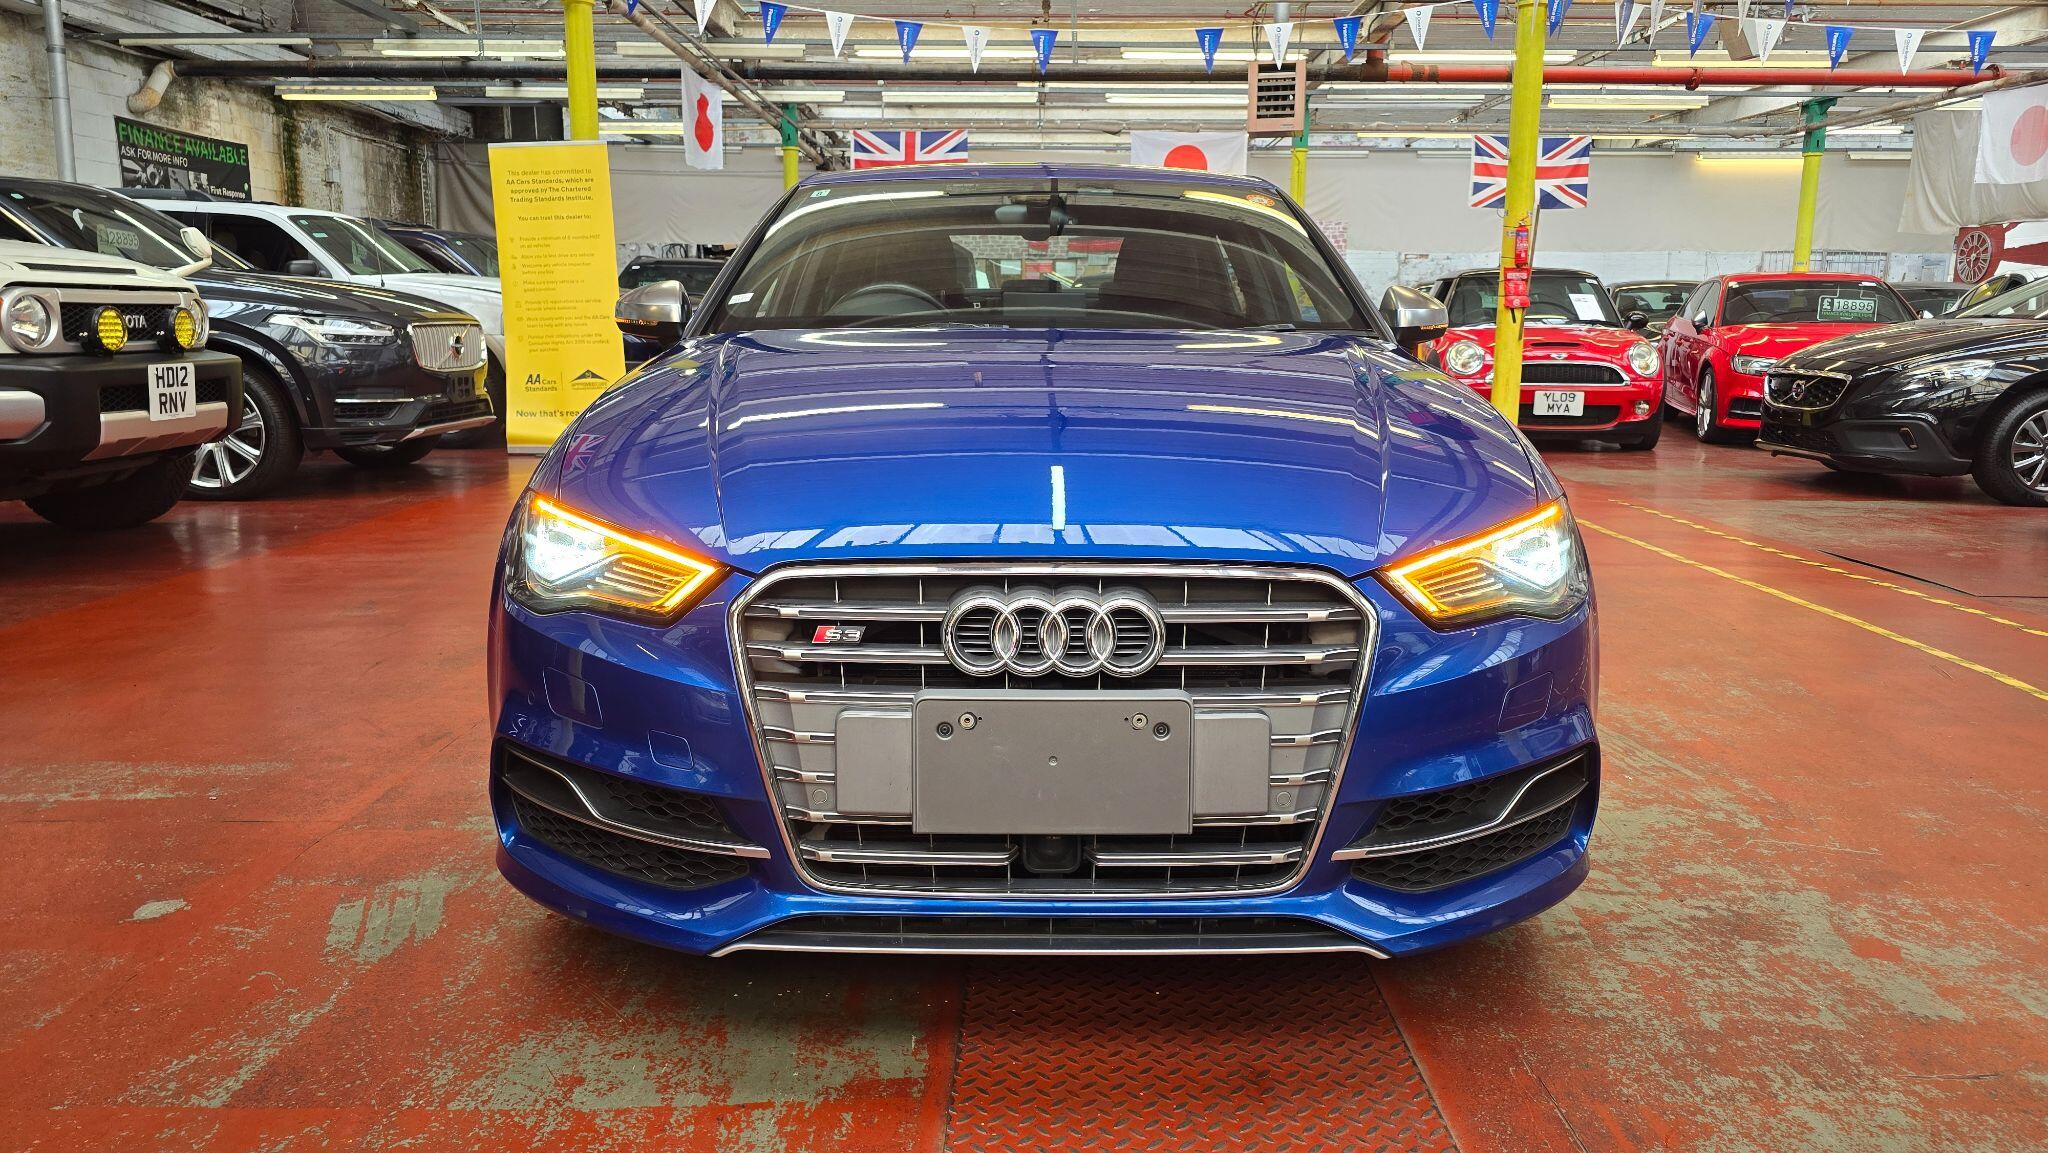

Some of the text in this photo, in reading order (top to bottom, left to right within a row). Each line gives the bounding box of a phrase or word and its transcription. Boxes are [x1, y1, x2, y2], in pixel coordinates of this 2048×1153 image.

[119, 122, 247, 166] FINANCE AVAILABLE
[121, 146, 188, 167] ASK FOR MORE INFO
[211, 186, 246, 199] First Response
[156, 366, 188, 388] HD12
[526, 374, 541, 385] AA
[159, 391, 186, 414] RNV
[1544, 392, 1576, 402] YL09
[516, 409, 538, 418] Now
[539, 409, 565, 418] that's
[1547, 403, 1569, 413] MYA
[824, 629, 861, 642] S3
